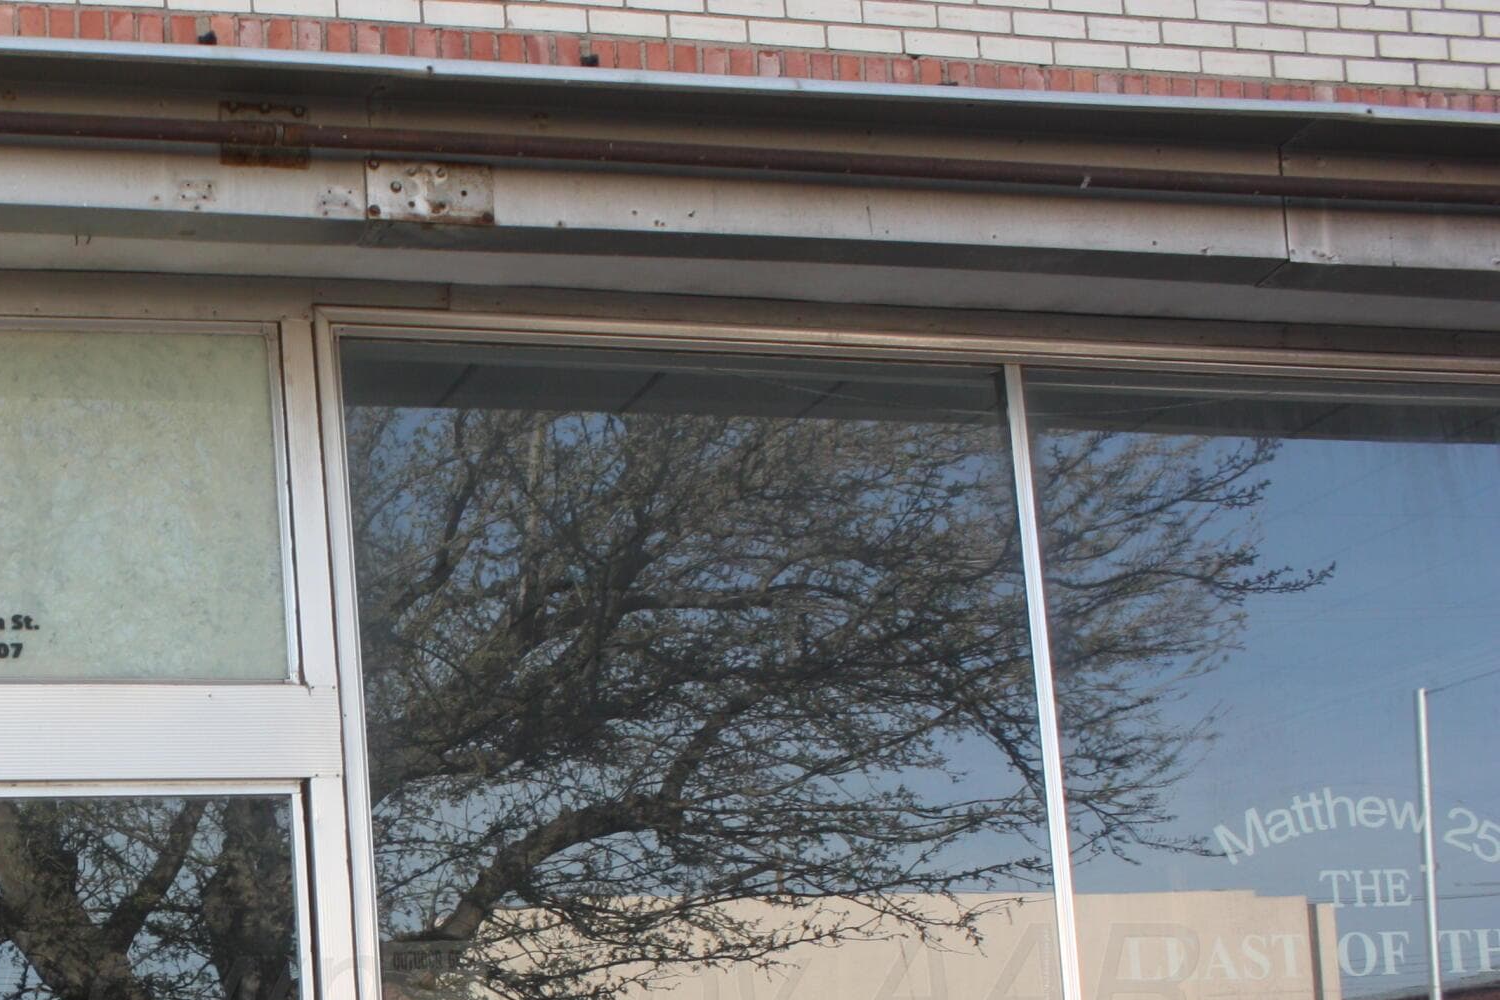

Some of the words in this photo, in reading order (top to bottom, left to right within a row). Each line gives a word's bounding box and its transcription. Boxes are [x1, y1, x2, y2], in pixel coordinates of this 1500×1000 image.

[11, 614, 41, 631] St.
[1213, 786, 1426, 865] Matthew
[1318, 867, 1413, 909] THE
[1337, 930, 1411, 978] OF
